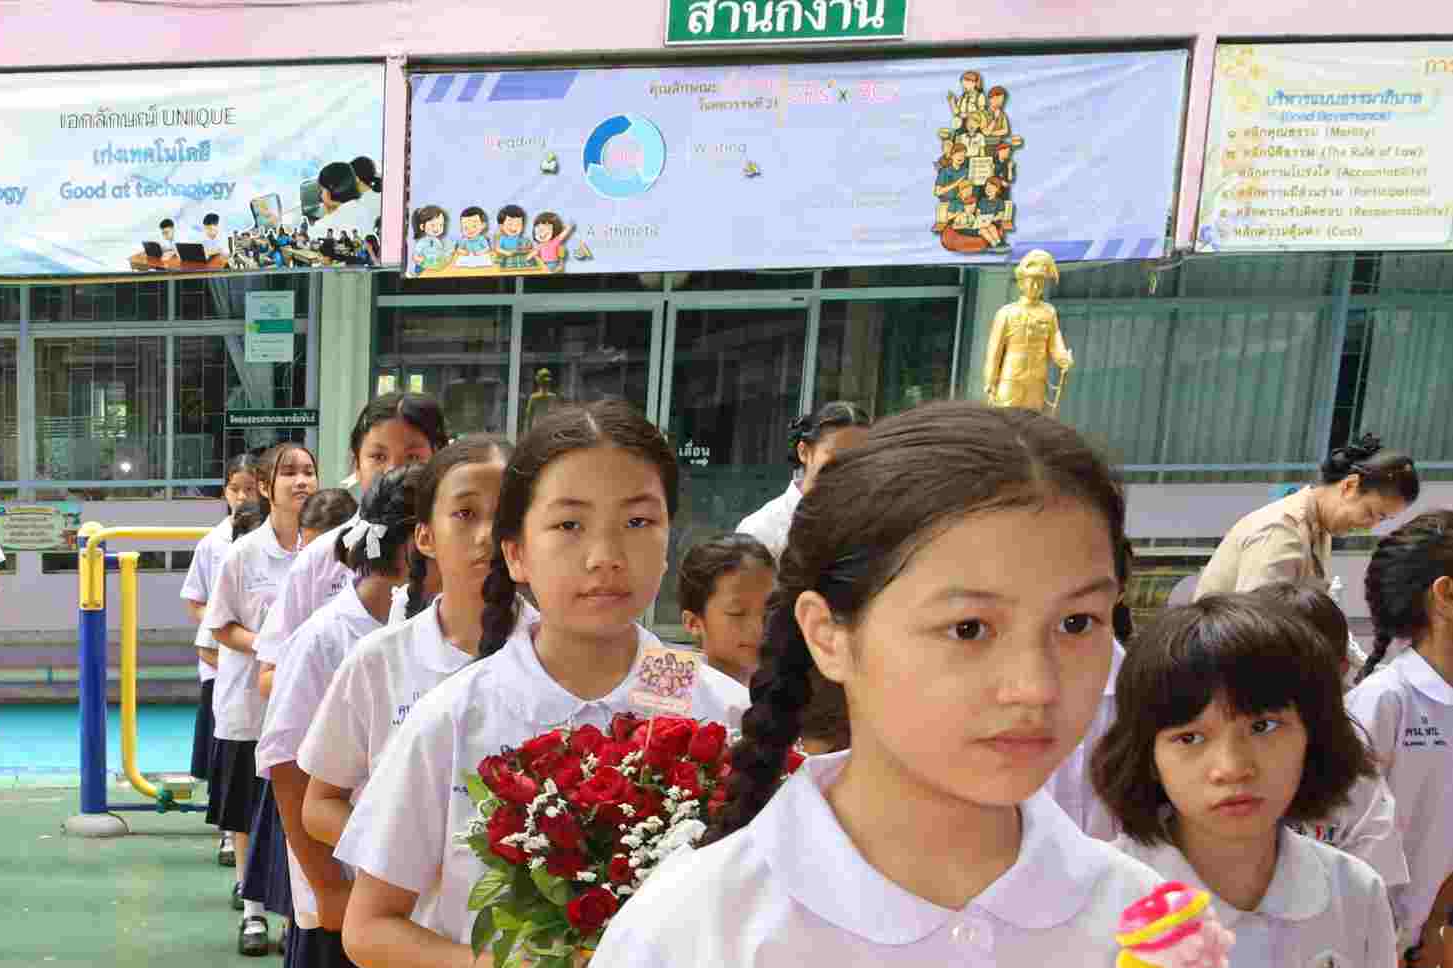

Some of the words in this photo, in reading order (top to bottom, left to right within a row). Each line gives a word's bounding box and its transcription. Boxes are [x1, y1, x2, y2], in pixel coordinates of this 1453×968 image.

[59, 104, 158, 129] เอกลักษณ์
[162, 105, 237, 129] UNIQUE
[59, 180, 108, 200] Good
[110, 179, 132, 200] at
